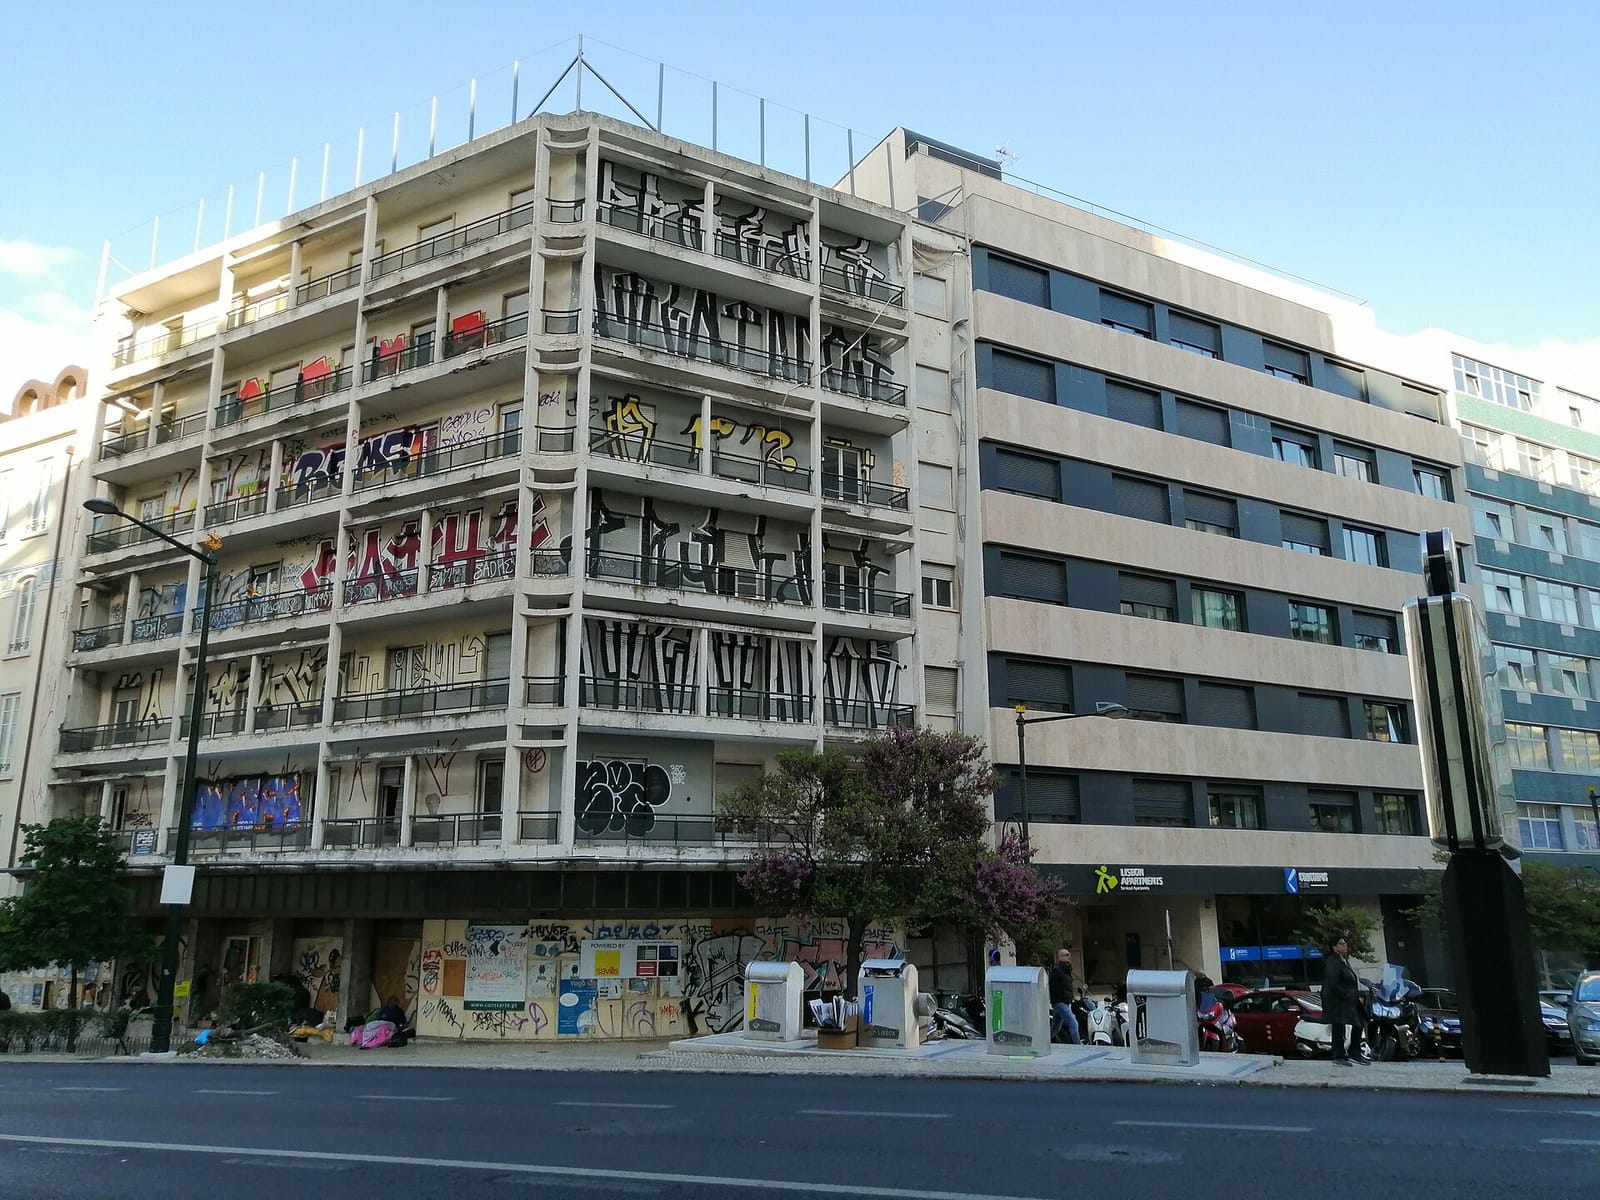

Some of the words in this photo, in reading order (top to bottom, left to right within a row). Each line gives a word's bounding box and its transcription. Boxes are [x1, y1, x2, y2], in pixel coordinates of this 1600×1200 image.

[1120, 868, 1145, 877] LISBON
[1120, 877, 1164, 886] APARTMENTS
[595, 967, 620, 976] savills
